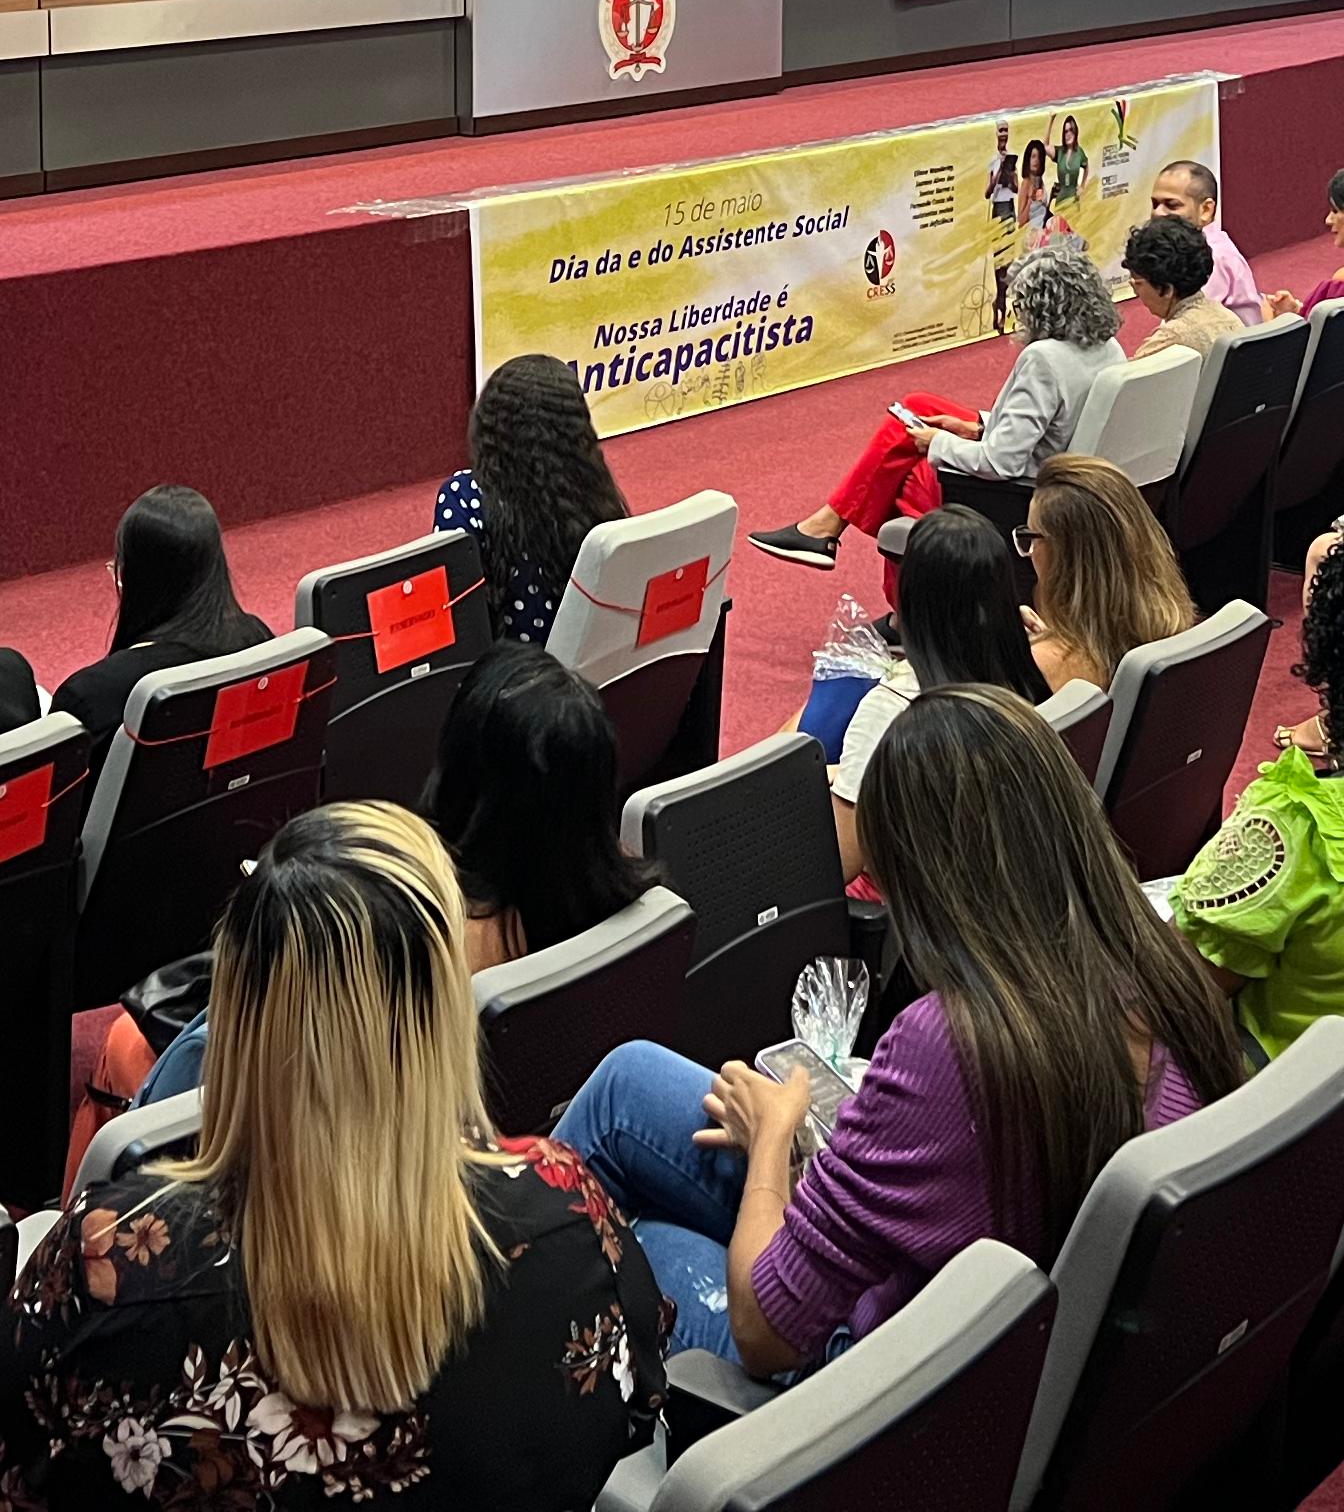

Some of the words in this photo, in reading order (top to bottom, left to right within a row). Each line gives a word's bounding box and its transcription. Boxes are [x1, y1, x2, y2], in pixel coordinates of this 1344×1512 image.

[664, 200, 687, 227] 15
[690, 196, 716, 223] de
[719, 189, 763, 217] maio
[549, 255, 588, 284] Dia
[595, 249, 622, 275] da
[627, 248, 642, 269] e
[647, 239, 675, 265] do
[678, 218, 788, 260] Assistente
[792, 205, 851, 237] Social
[866, 282, 896, 299] CRESS
[593, 317, 664, 349] Nossa
[668, 290, 772, 333] Liberdade
[776, 284, 790, 308] é
